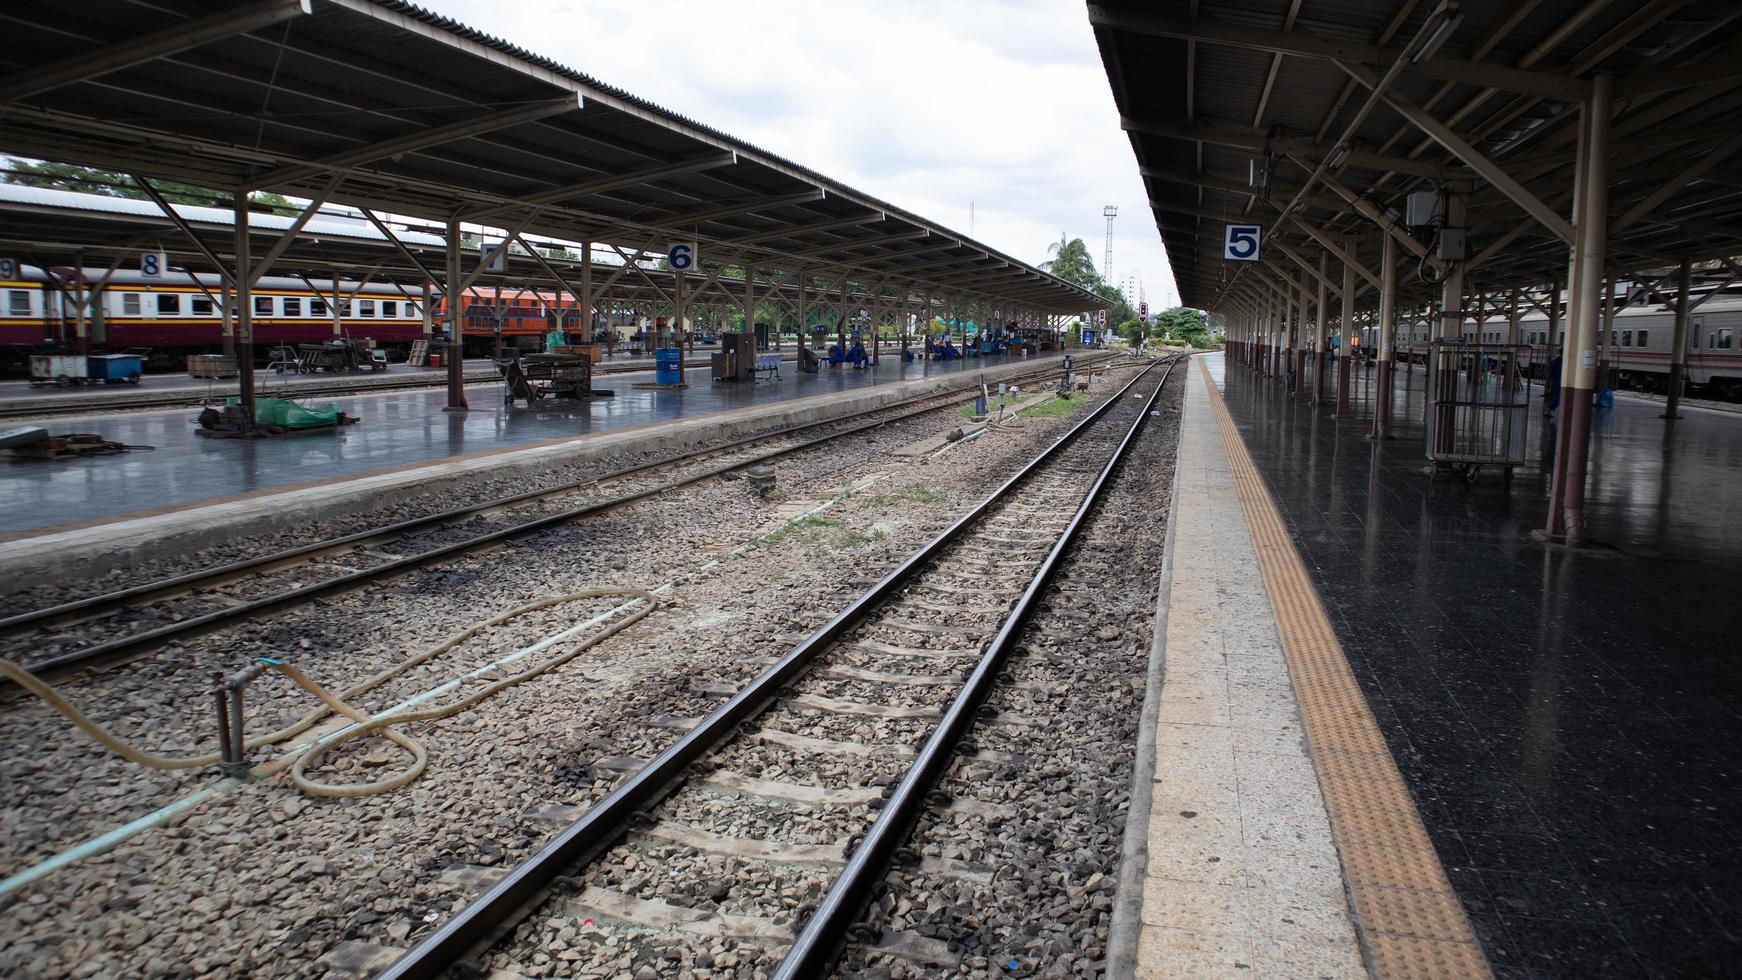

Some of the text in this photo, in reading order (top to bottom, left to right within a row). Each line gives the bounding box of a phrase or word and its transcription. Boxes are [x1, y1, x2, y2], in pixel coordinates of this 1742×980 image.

[1229, 228, 1257, 258] 5
[144, 255, 158, 275] 8
[670, 245, 691, 269] 6
[0, 260, 13, 279] 9
